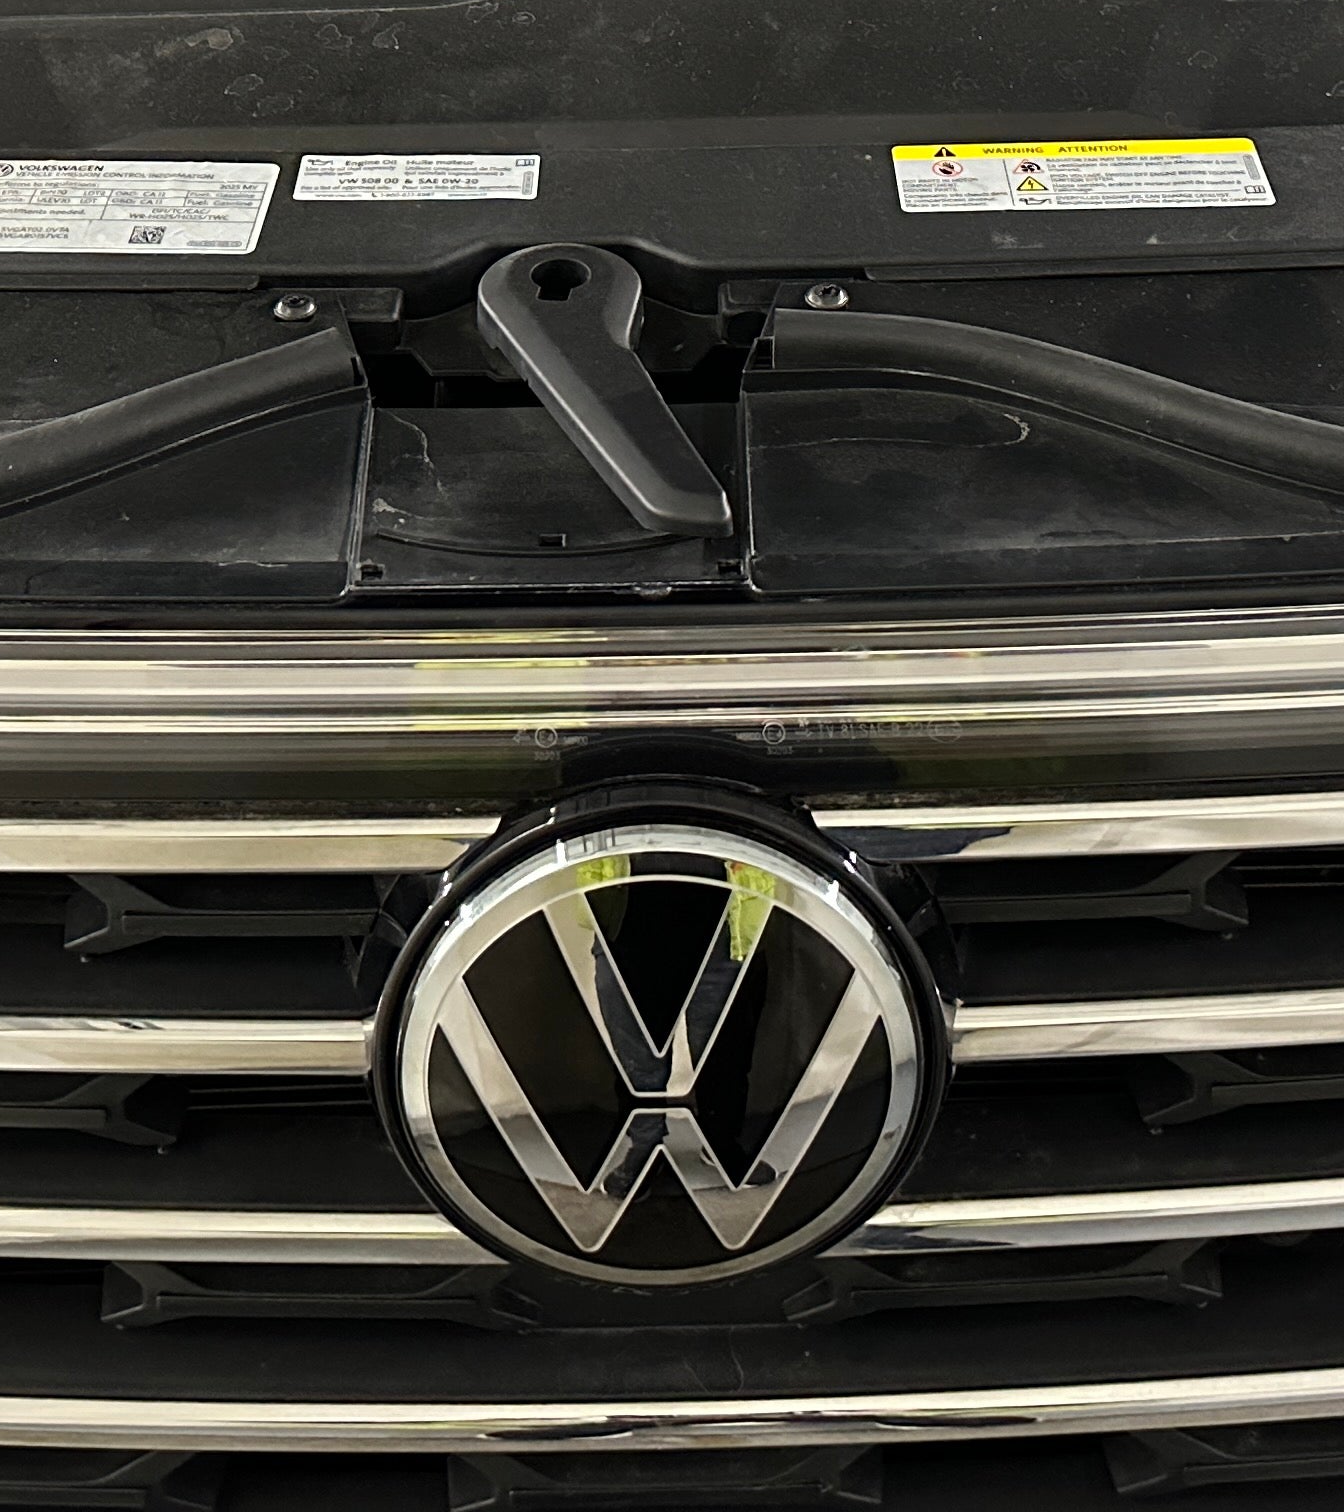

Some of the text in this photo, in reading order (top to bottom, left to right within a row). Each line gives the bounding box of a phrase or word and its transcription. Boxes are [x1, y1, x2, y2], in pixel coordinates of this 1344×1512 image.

[983, 144, 1128, 155] WARNING ATTENTION
[345, 159, 380, 167] Engine
[18, 164, 104, 172] VOLKSWAGEN
[436, 875, 884, 1254] VW
